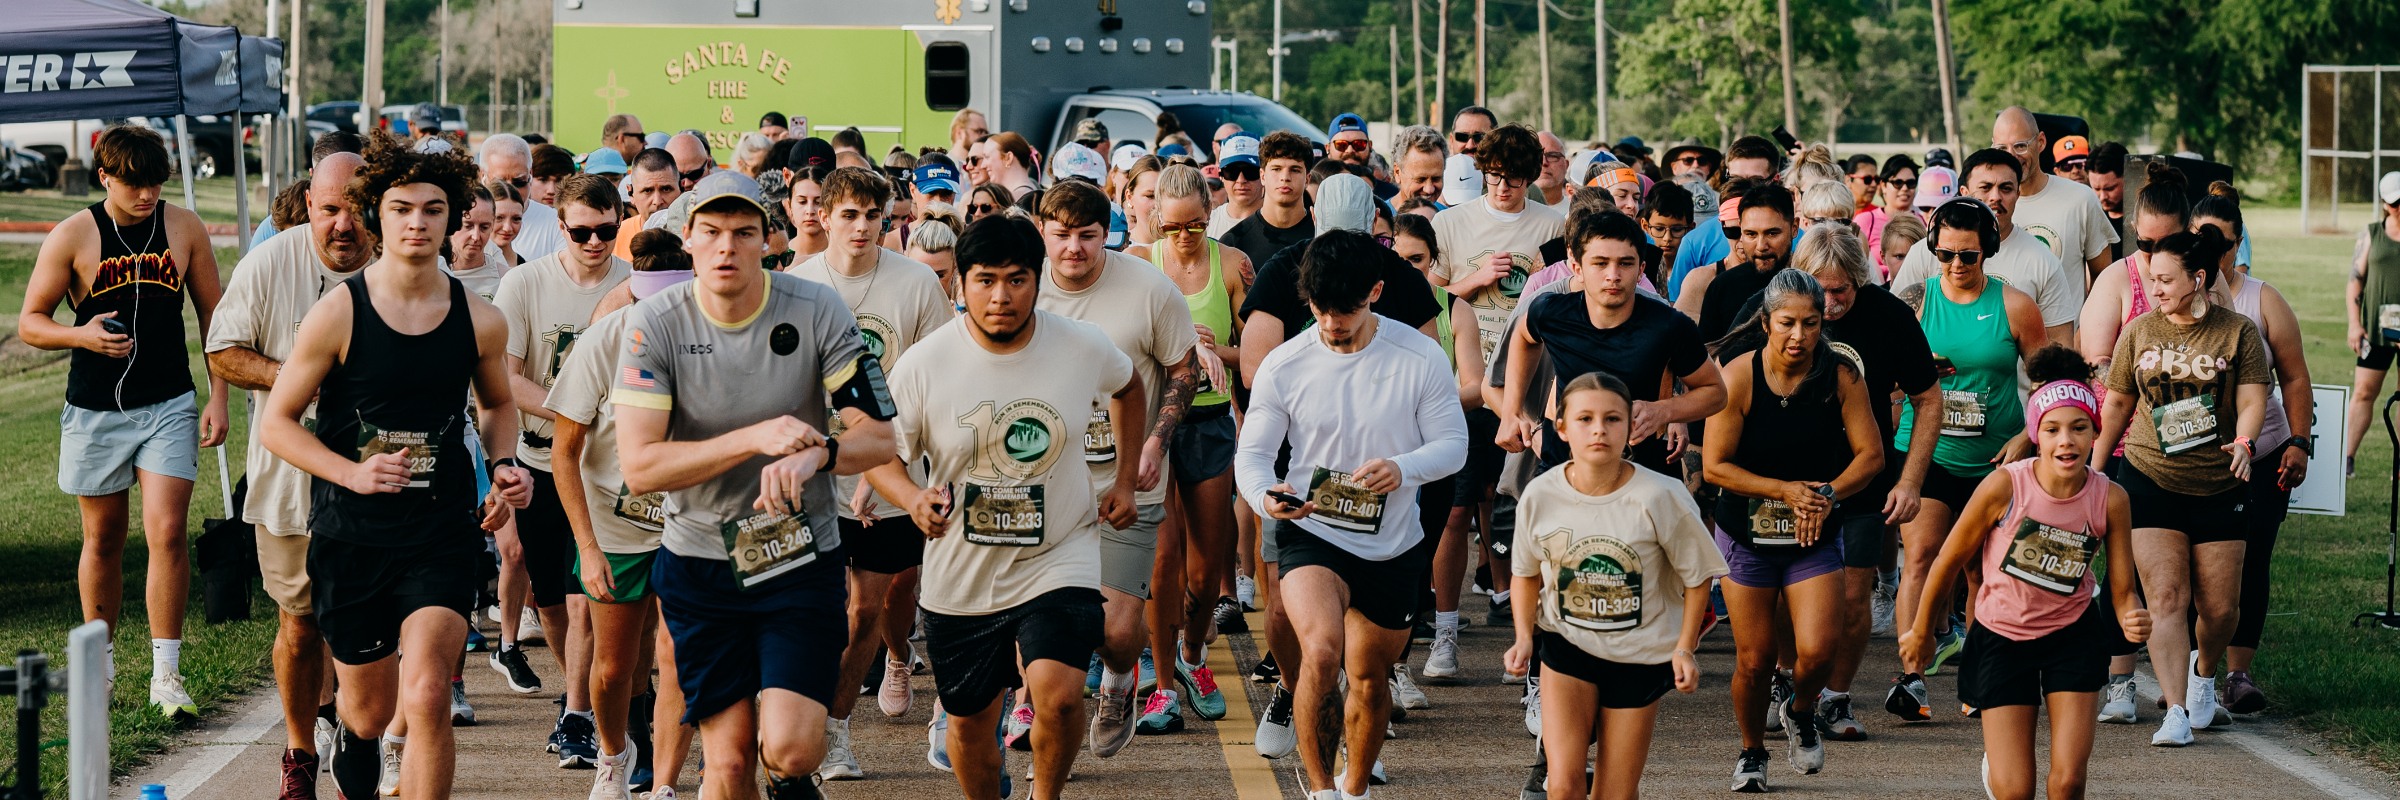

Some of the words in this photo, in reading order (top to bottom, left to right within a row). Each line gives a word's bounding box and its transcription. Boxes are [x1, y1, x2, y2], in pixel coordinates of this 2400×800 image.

[665, 41, 749, 85] SANTA
[757, 48, 793, 85] FE
[708, 80, 748, 99] FIRE
[720, 104, 735, 124] &
[704, 130, 744, 150] ESC
[90, 248, 181, 297] MUSTANGS
[842, 326, 859, 342] INE
[679, 344, 713, 355] INEOS
[1830, 343, 1860, 361] EMEMBRANCE
[2161, 349, 2216, 380] Be
[2034, 384, 2097, 415] MUDGIRL
[994, 412, 1006, 425] RUN
[1013, 401, 1060, 421] REMEMBRANCE
[1004, 409, 1024, 425] SANTA
[1950, 411, 1985, 426] 10-376
[377, 428, 388, 437] WE
[2179, 414, 2217, 436] 10-323
[1084, 432, 1116, 449] 0-118
[409, 456, 437, 473] 232
[1340, 480, 1371, 491] REMEM
[646, 505, 665, 520] 10-
[1338, 497, 1383, 518] 10-401
[736, 519, 748, 528] WE
[748, 513, 770, 524] COM
[994, 512, 1043, 529] 10-233
[1775, 518, 1797, 533] 10-
[740, 525, 752, 534] TO
[2039, 523, 2050, 532] WE
[2050, 527, 2072, 540] COME
[2071, 534, 2089, 543] HERE
[761, 525, 813, 560] 10-248
[1568, 544, 1581, 556] RUN
[1591, 538, 1637, 561] REMEMBRANCE
[2048, 535, 2084, 548] REMEMBER
[2040, 553, 2087, 578] 10-370
[1585, 572, 1609, 580] COME
[1587, 578, 1625, 586] REMEMBER
[1589, 596, 1640, 616] 10-329
